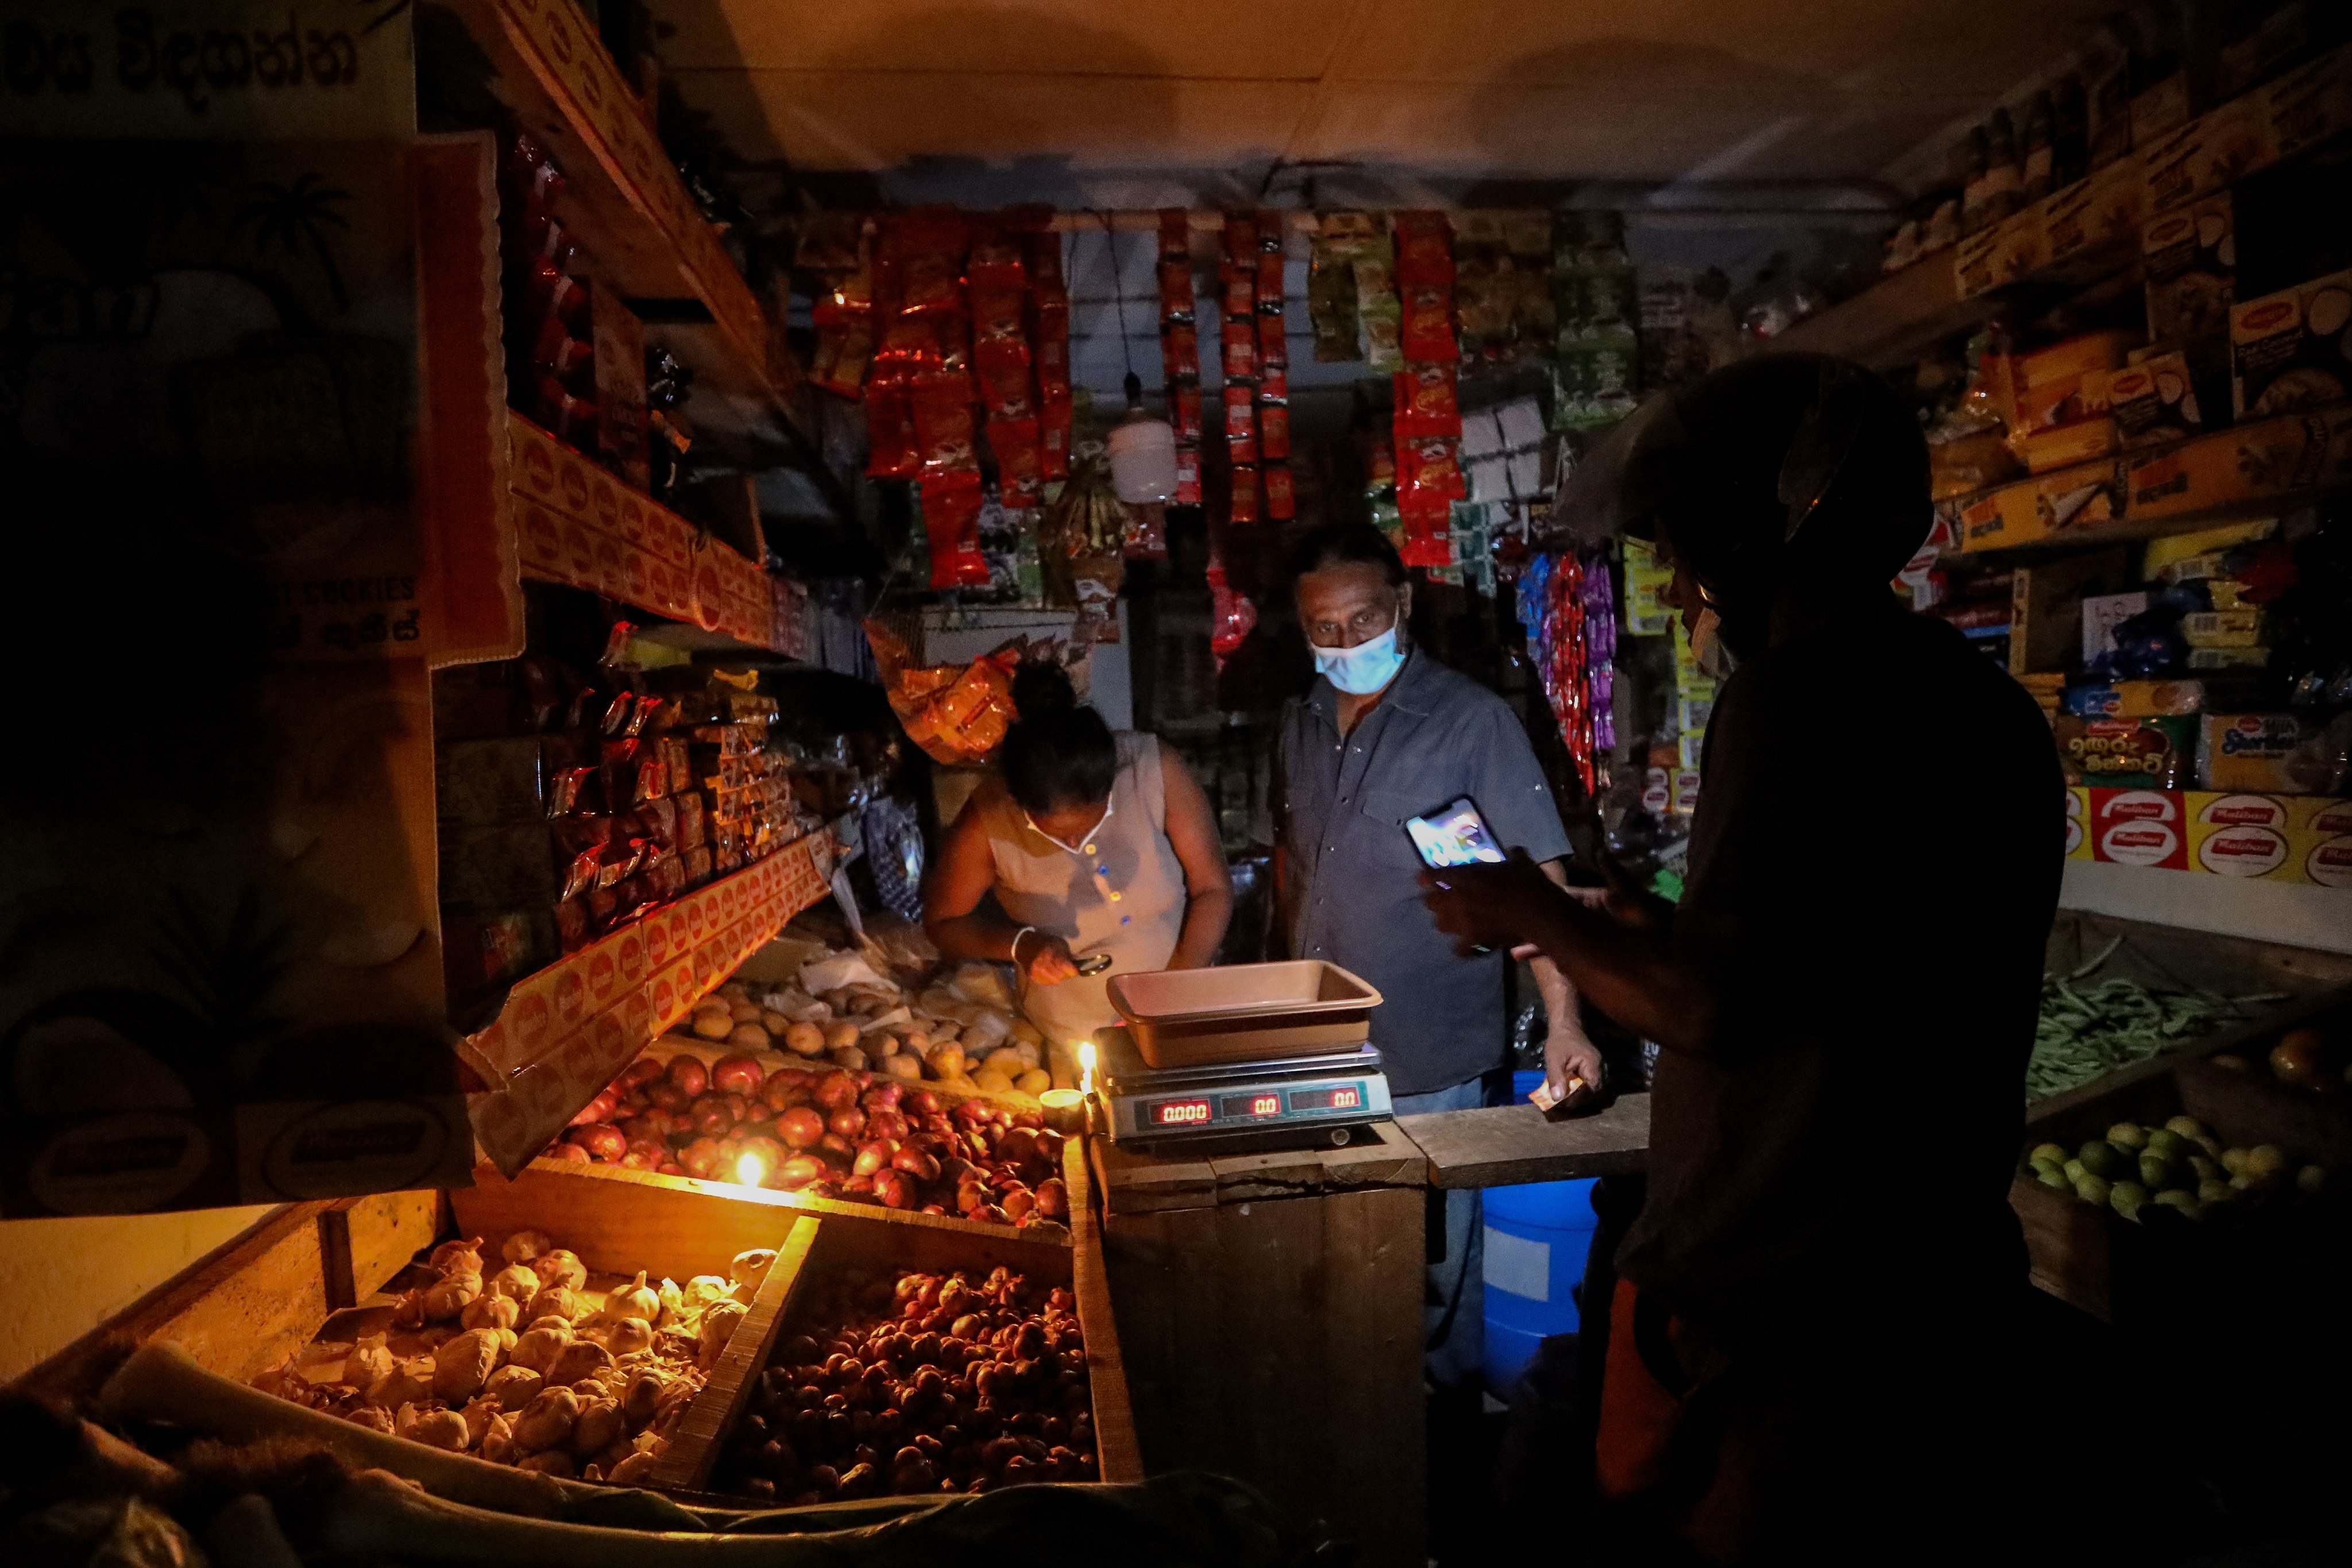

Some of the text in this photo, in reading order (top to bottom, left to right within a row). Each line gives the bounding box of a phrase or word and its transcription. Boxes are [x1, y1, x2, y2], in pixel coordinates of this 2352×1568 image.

[304, 576, 415, 604] COOKIES
[1163, 1104, 1206, 1121] 0.000
[1256, 1098, 1276, 1114] 0.0
[1334, 1092, 1354, 1107] 0.0
